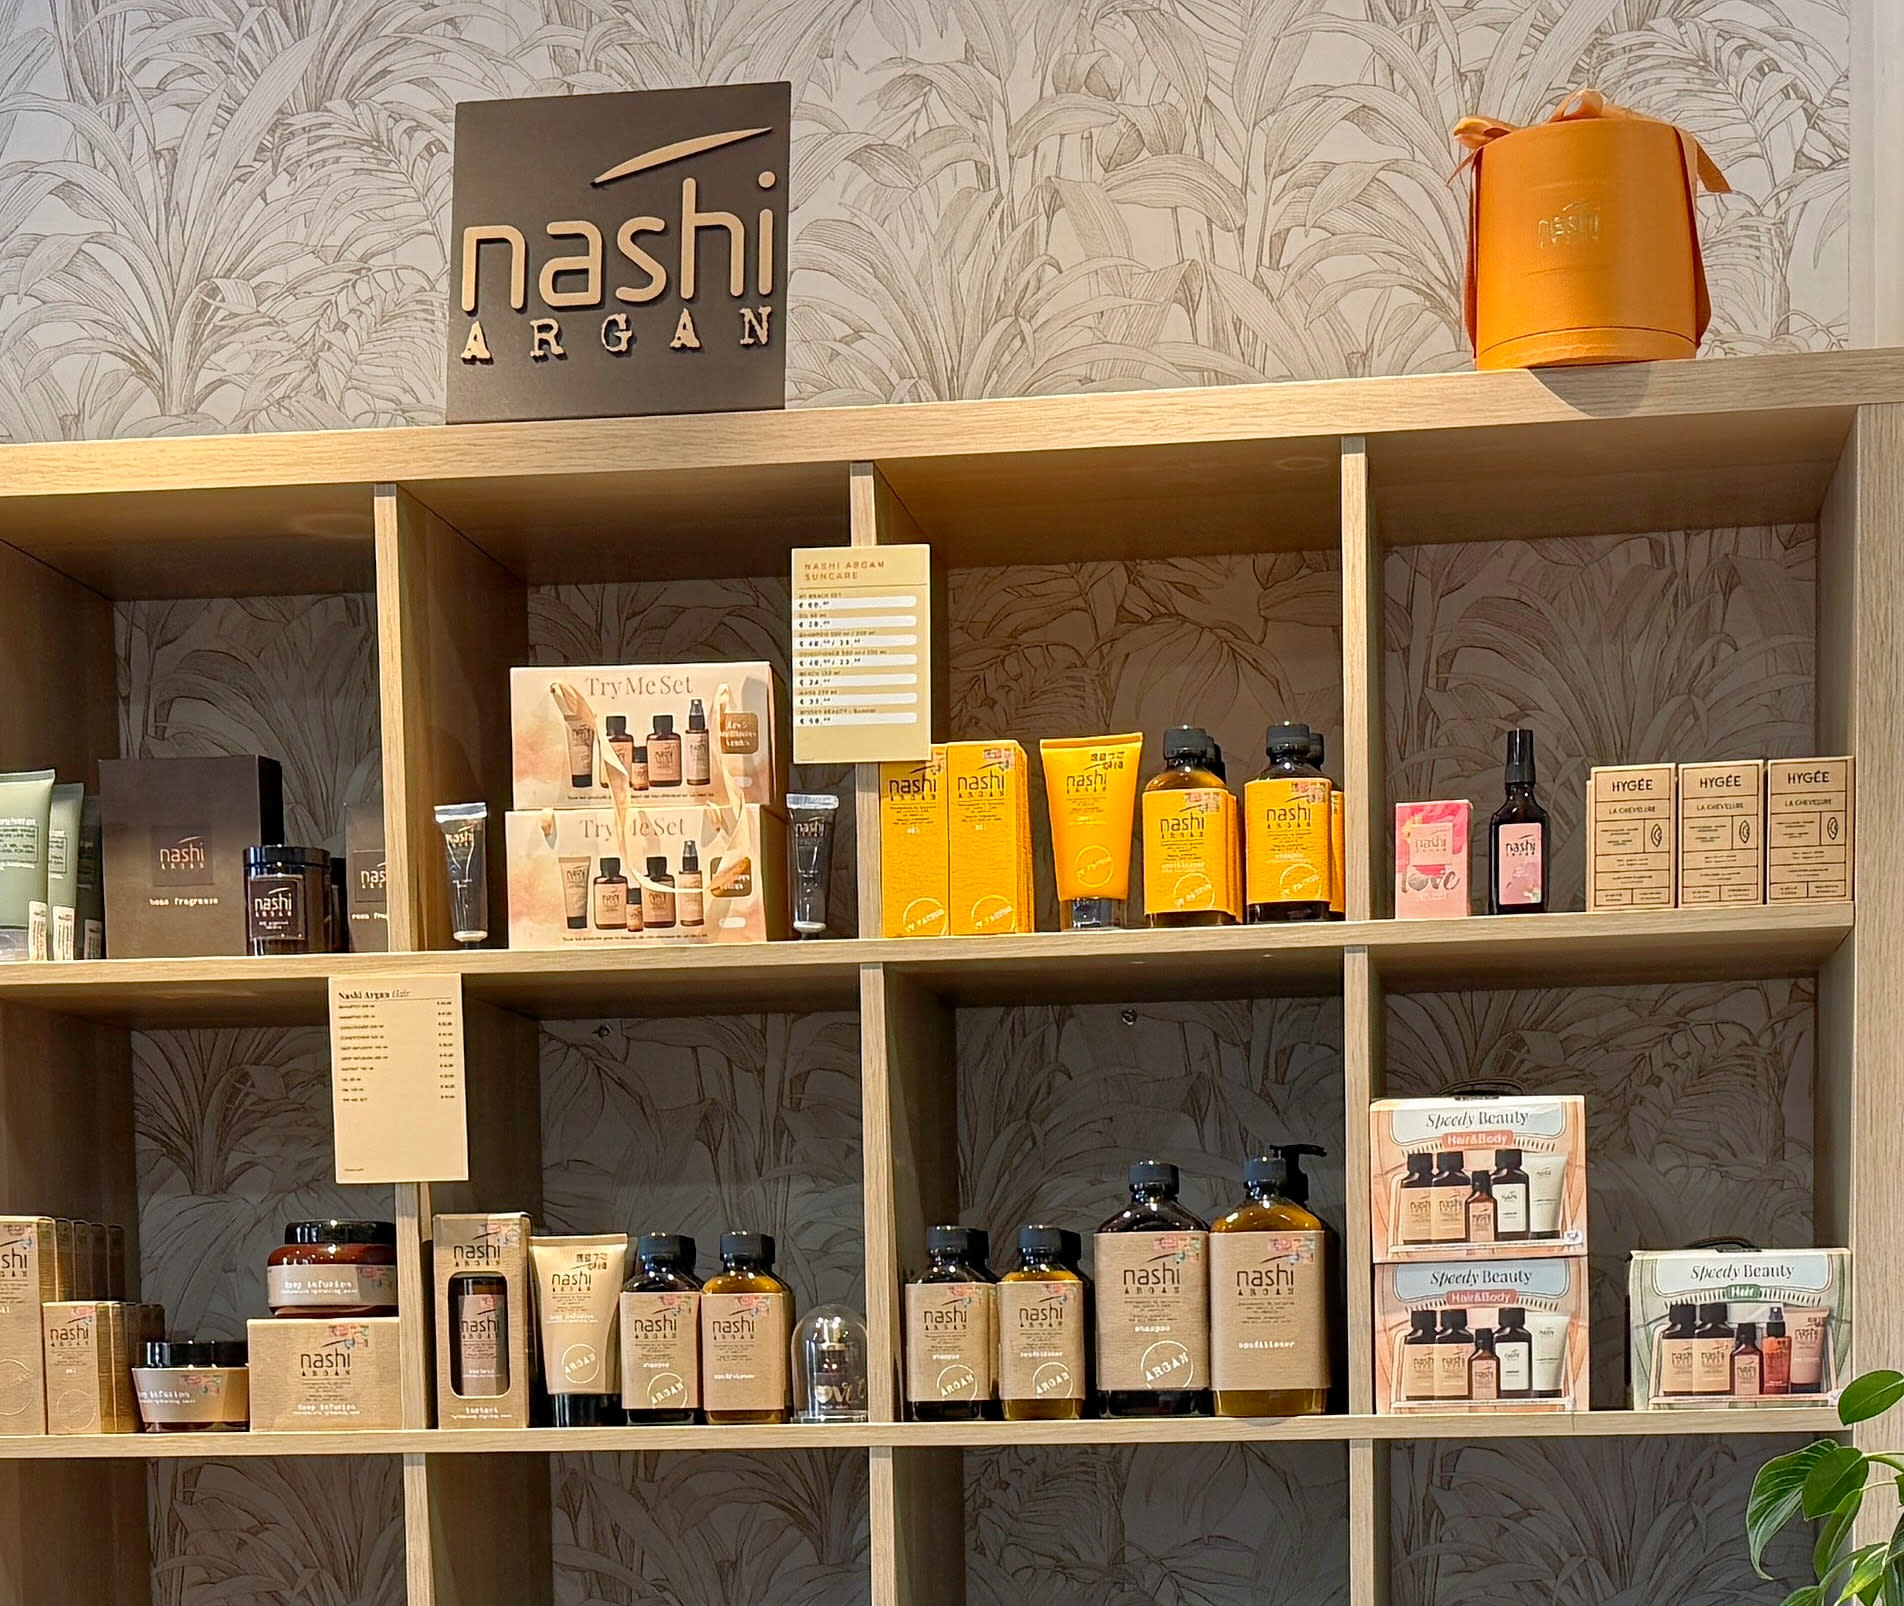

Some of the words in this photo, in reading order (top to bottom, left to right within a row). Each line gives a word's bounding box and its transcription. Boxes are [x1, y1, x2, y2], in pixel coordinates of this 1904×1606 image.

[461, 170, 777, 313] nashi
[460, 305, 774, 362] ARGAN
[585, 676, 622, 700] Try
[626, 676, 656, 696] Me
[660, 674, 694, 695] Set
[889, 771, 937, 794] nashi
[957, 768, 1005, 790] nashi
[1611, 777, 1654, 792] HYGÉE
[1699, 773, 1742, 789] HYGÉE
[1787, 769, 1830, 785] HYGÉE
[1266, 800, 1311, 822] nashi
[579, 816, 612, 842] Try
[653, 815, 686, 837] Set
[1160, 811, 1205, 833] nashi
[160, 841, 205, 863] nashi
[1505, 836, 1536, 853] nashi
[360, 866, 386, 885] nas
[254, 892, 293, 911] nashi
[1425, 1112, 1475, 1130] Speedy
[1478, 1110, 1529, 1127] Beauty
[453, 1237, 501, 1261] nashi
[551, 1270, 592, 1287] nashi
[1123, 1261, 1180, 1285] nashi
[1236, 1263, 1294, 1287] nashi
[1430, 1269, 1480, 1287] Speedy
[1482, 1268, 1533, 1286] Beauty
[1690, 1263, 1741, 1282] Speedy
[1743, 1263, 1795, 1280] Beauty
[923, 1304, 967, 1324] nashi
[1019, 1302, 1063, 1322] nashi
[50, 1323, 89, 1341] nashi
[634, 1313, 678, 1333] nashi
[712, 1314, 755, 1334] nashi
[300, 1346, 352, 1369] nashi
[1145, 1352, 1189, 1383] ARGAN
